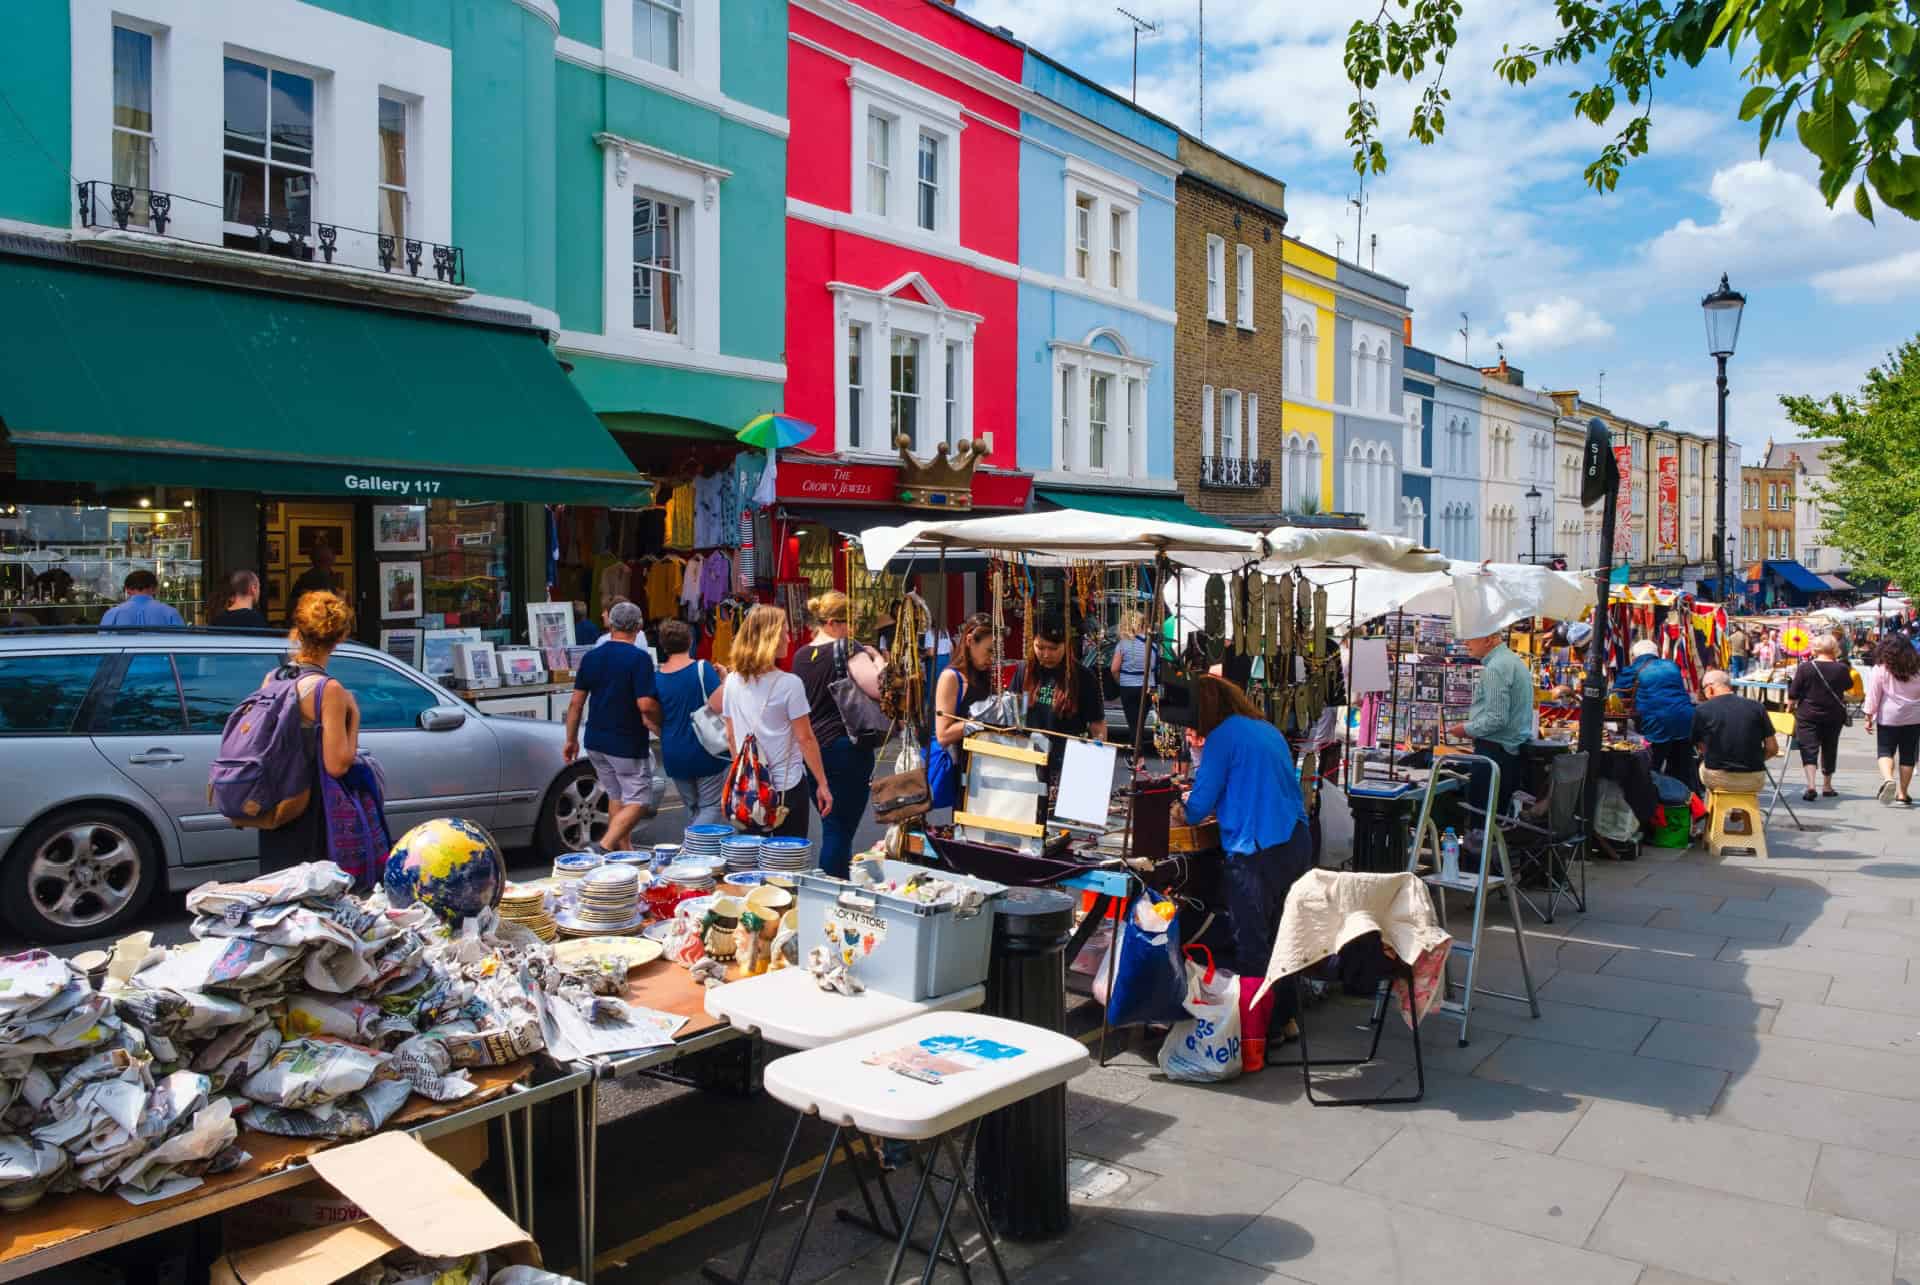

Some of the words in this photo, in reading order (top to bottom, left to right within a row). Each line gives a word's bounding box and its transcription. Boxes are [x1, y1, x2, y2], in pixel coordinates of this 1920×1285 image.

[344, 474, 410, 495] Gallery
[414, 480, 440, 493] 117
[801, 479, 837, 493] CROWN
[861, 914, 887, 929] STORE
